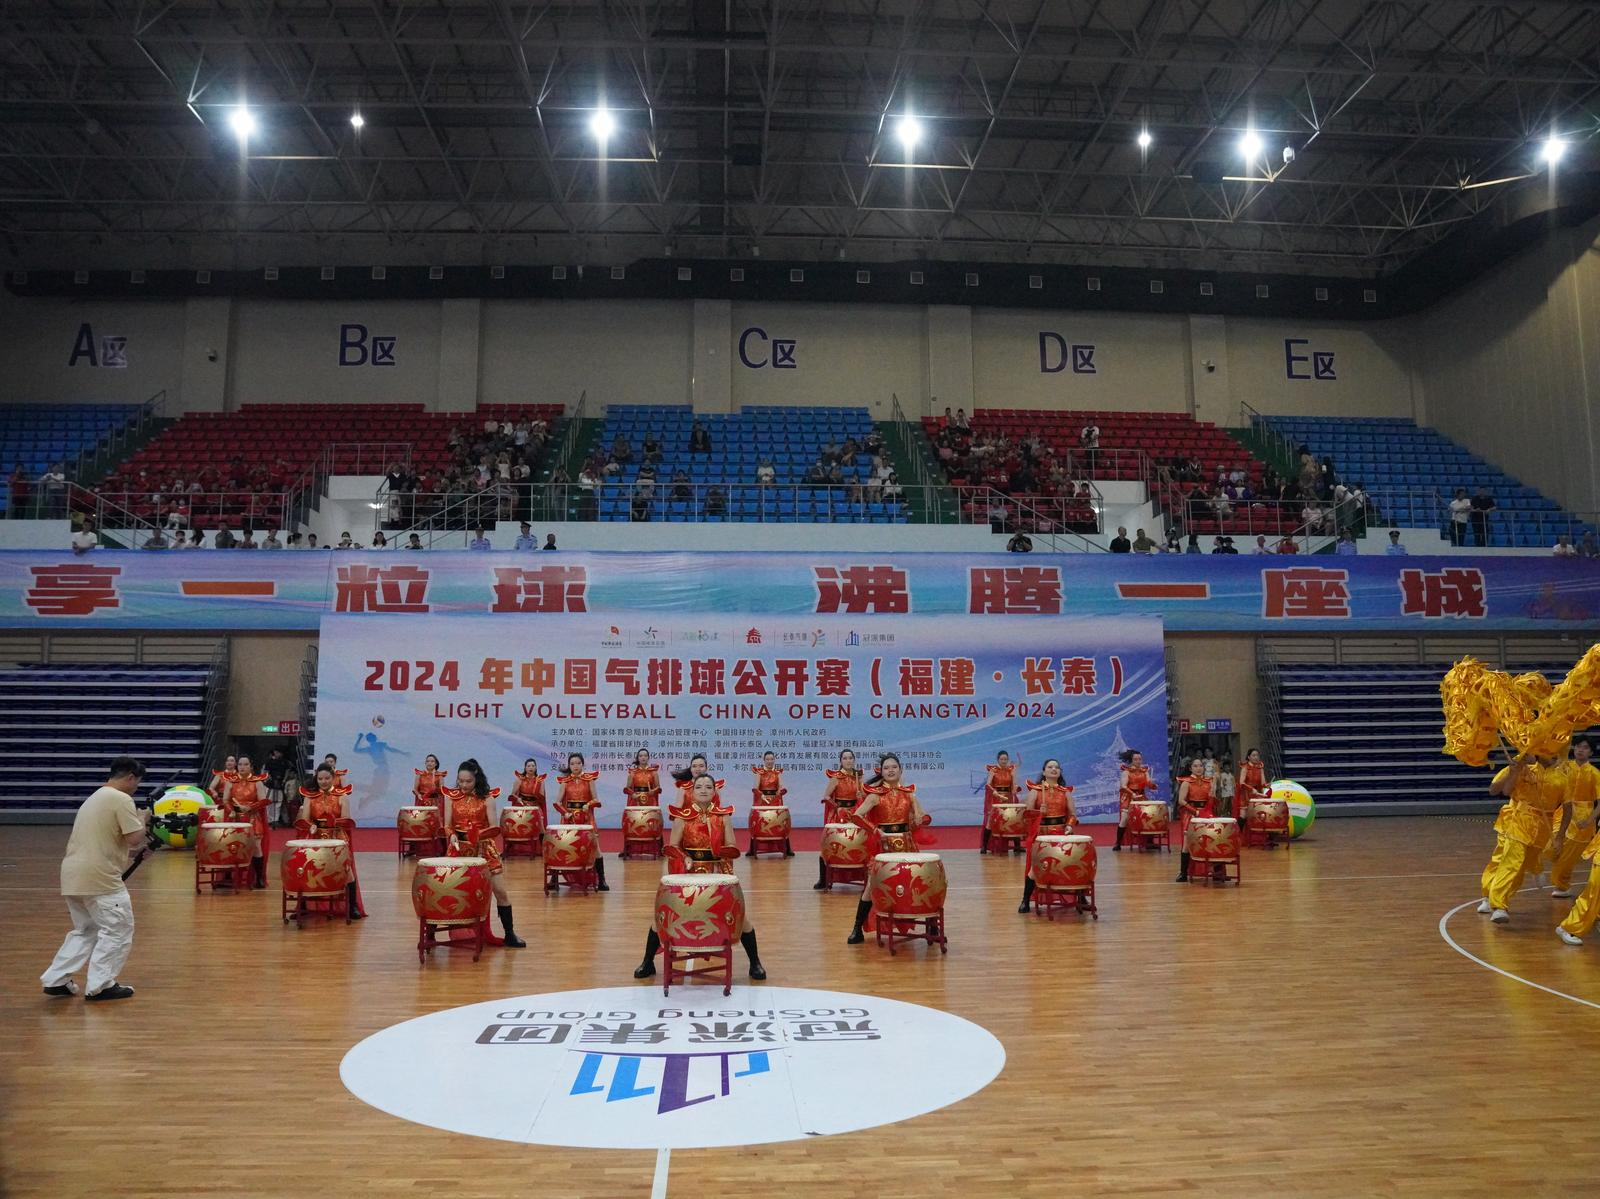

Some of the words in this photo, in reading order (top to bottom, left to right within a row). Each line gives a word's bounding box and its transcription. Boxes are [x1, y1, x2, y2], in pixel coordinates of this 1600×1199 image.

[339, 324, 396, 366] B区
[739, 328, 796, 368] C区
[1039, 332, 1096, 373] D区
[1285, 339, 1336, 380] E区
[364, 660, 461, 691] 2024
[434, 703, 504, 719] LIGHT
[521, 703, 676, 719] VOLLEYBALL
[699, 703, 772, 719] CHINA
[788, 703, 851, 719] OPEN
[869, 703, 988, 719] CHANGTAI
[1005, 703, 1056, 718] 2024
[658, 740, 708, 748] 漳州市体育局
[714, 740, 796, 748] 漳州市长泰区人民政府
[802, 740, 884, 748] 福建冠深集团有限公司
[714, 728, 763, 736] 中国排球协会
[770, 728, 827, 736] 漳州市人民政府
[496, 1010, 637, 1020] Group
[658, 1008, 870, 1019] GoSheng
[474, 1020, 882, 1045] 冠深集团
